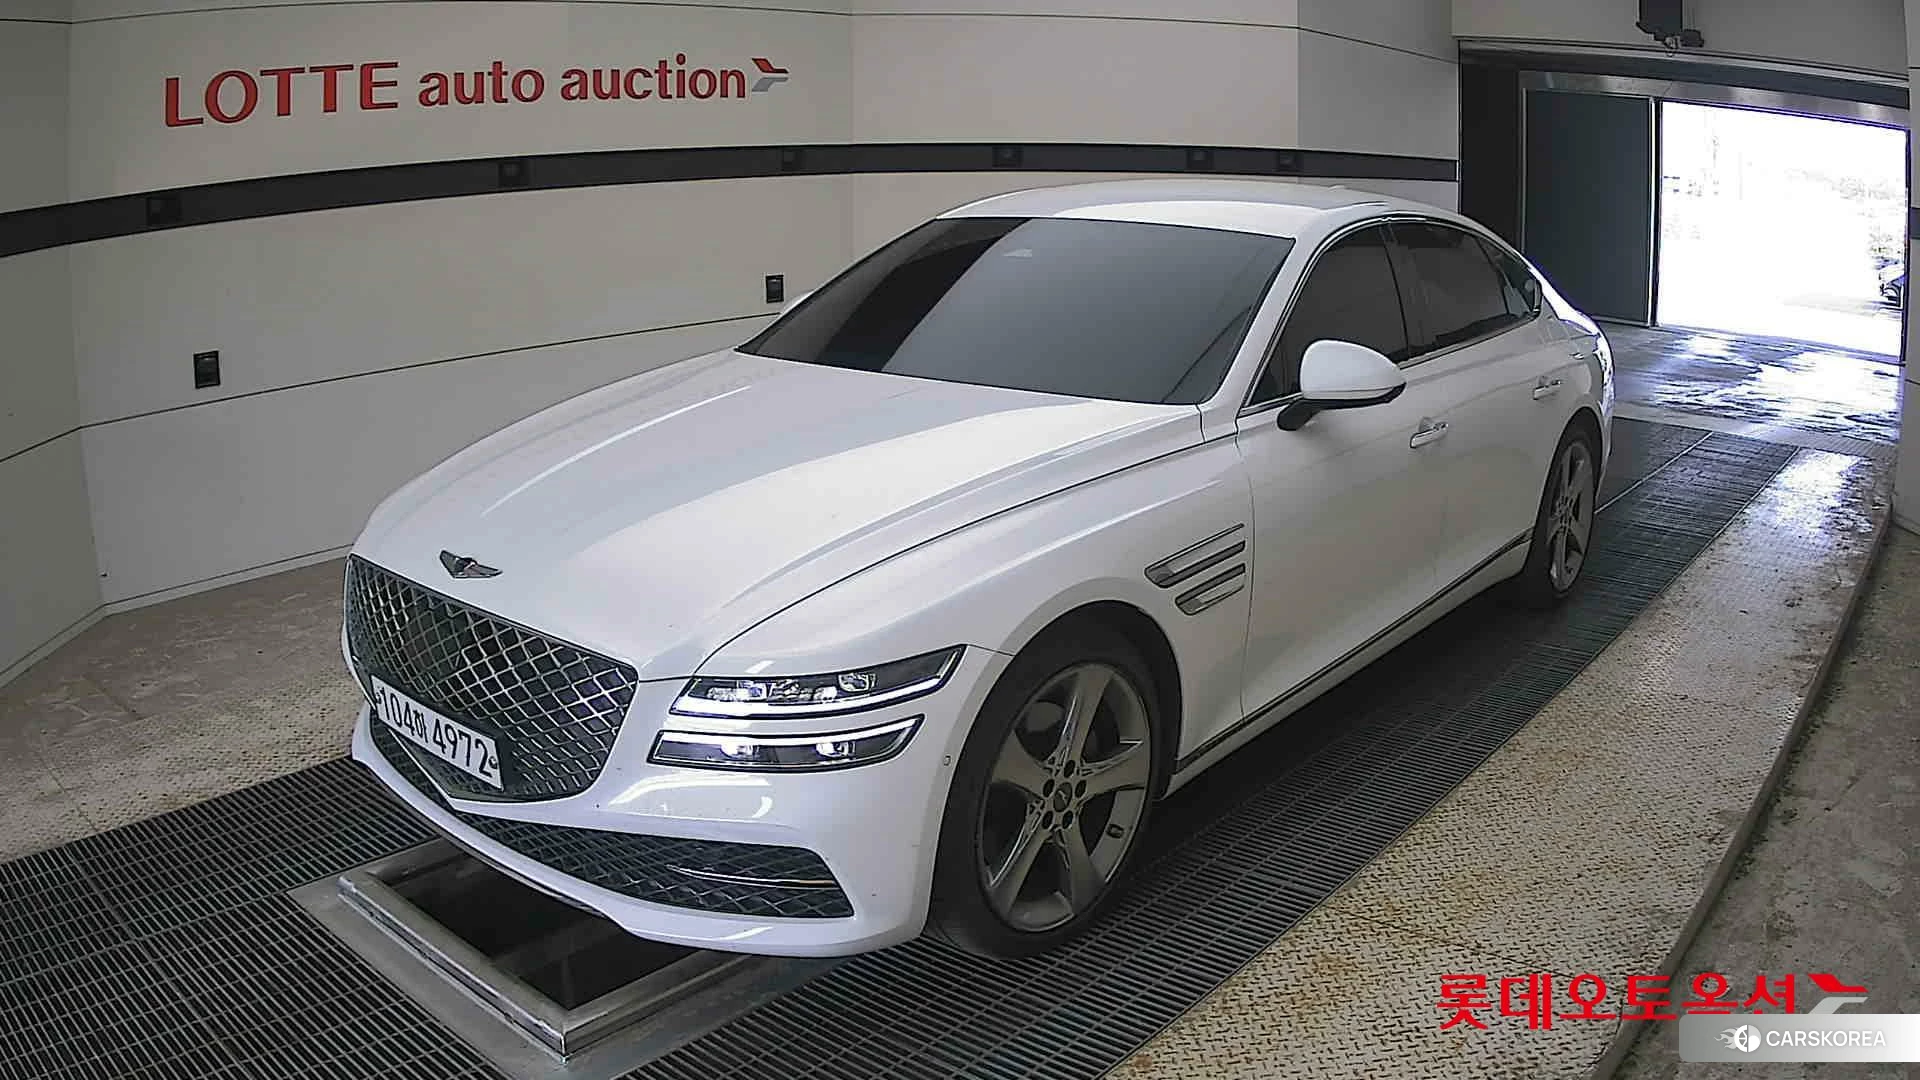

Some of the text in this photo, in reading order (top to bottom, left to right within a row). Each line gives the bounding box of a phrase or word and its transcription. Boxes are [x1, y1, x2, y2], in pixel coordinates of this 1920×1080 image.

[165, 53, 747, 127] LOTTE auto auction
[432, 718, 493, 778] 4972
